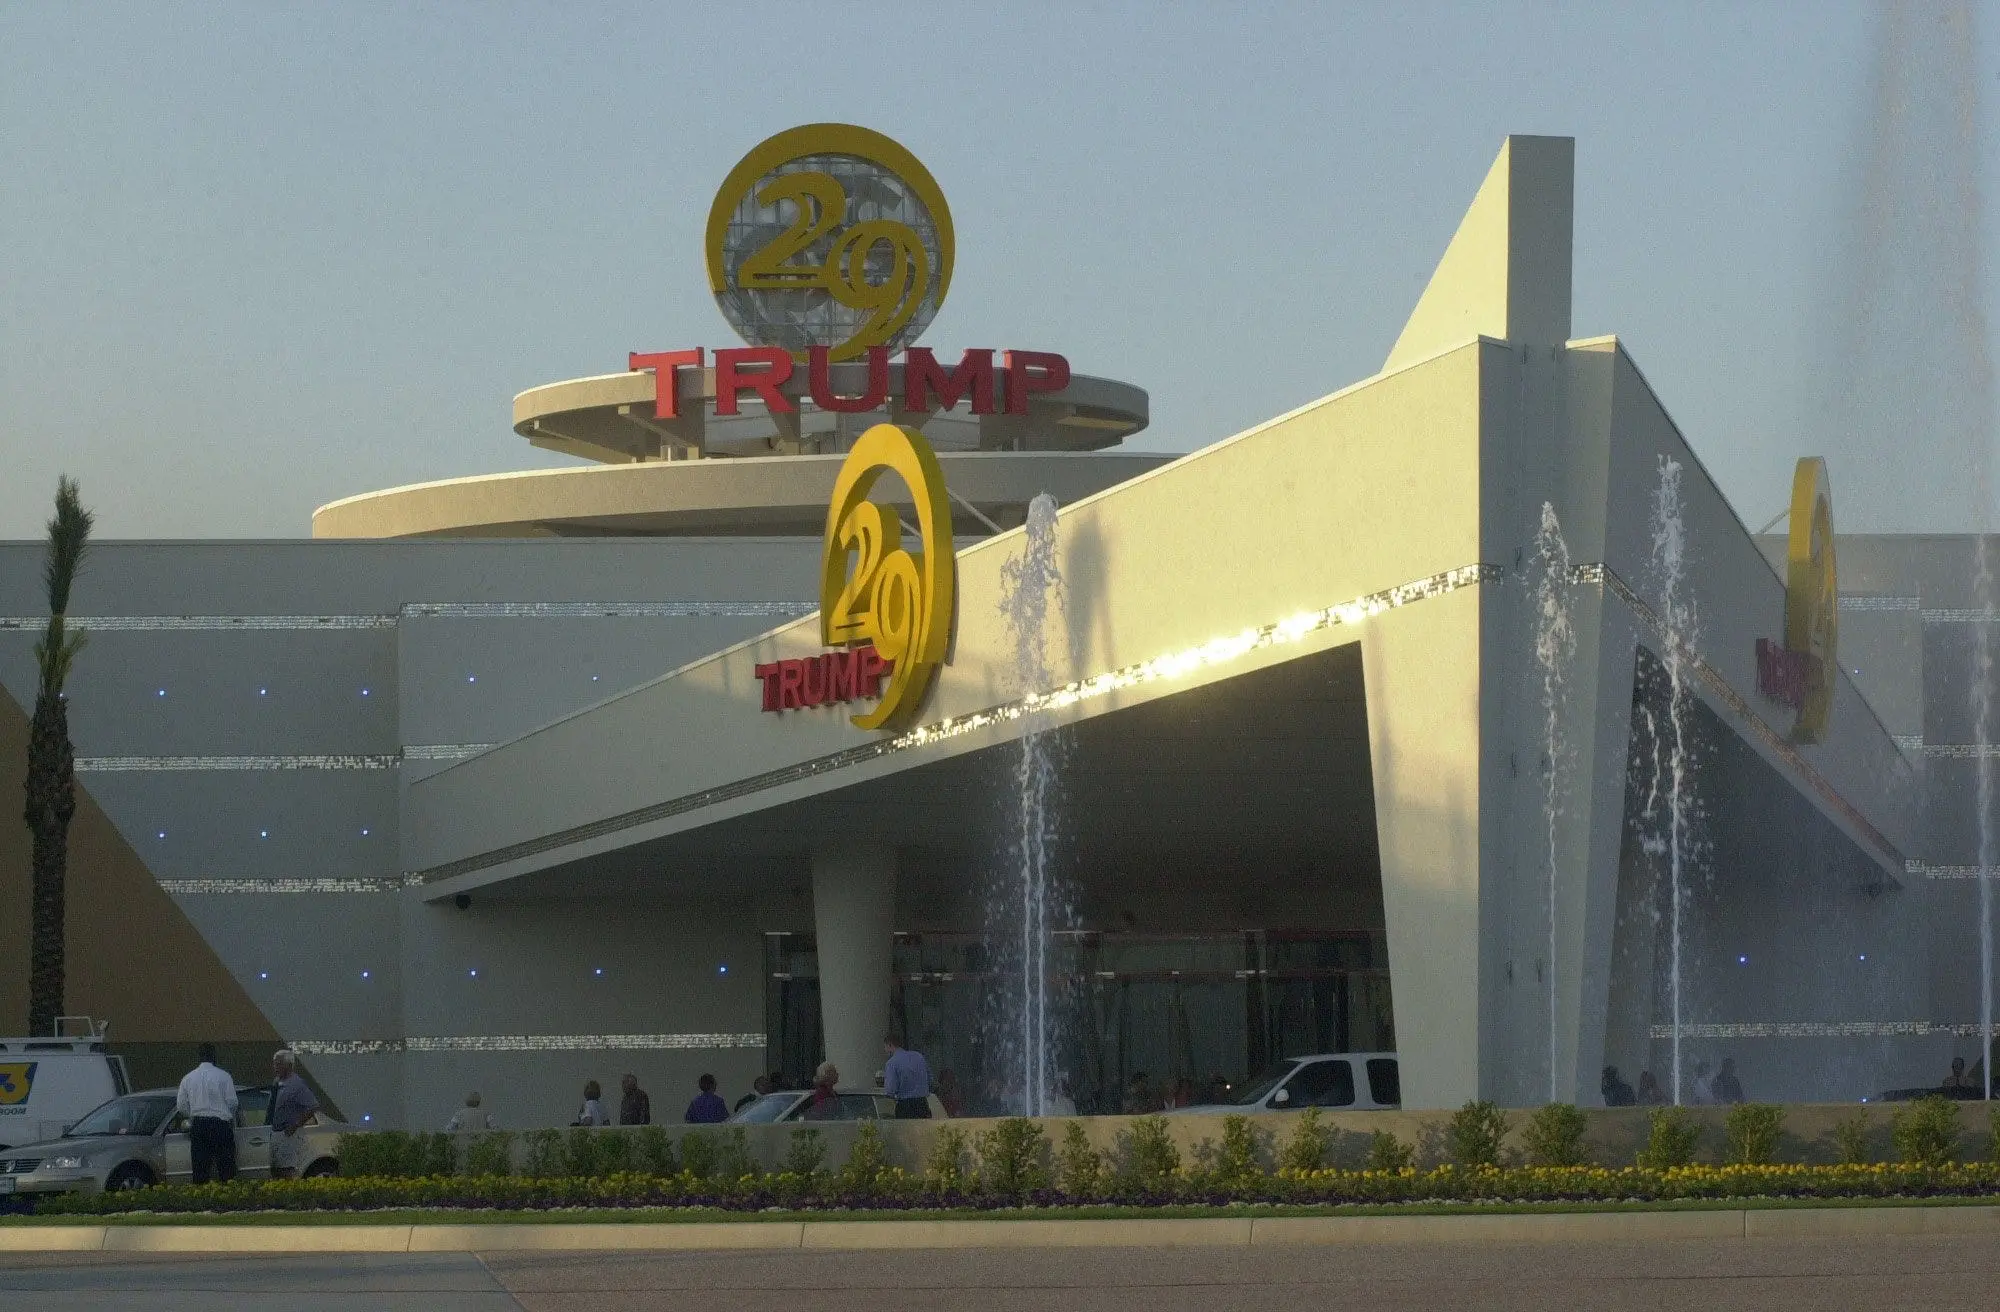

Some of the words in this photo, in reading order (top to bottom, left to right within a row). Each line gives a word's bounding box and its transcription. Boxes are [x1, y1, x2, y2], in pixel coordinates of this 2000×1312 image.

[737, 170, 928, 364] 29
[628, 345, 1071, 419] TRUMP
[755, 646, 895, 712] TRUMP
[828, 501, 921, 731] 29
